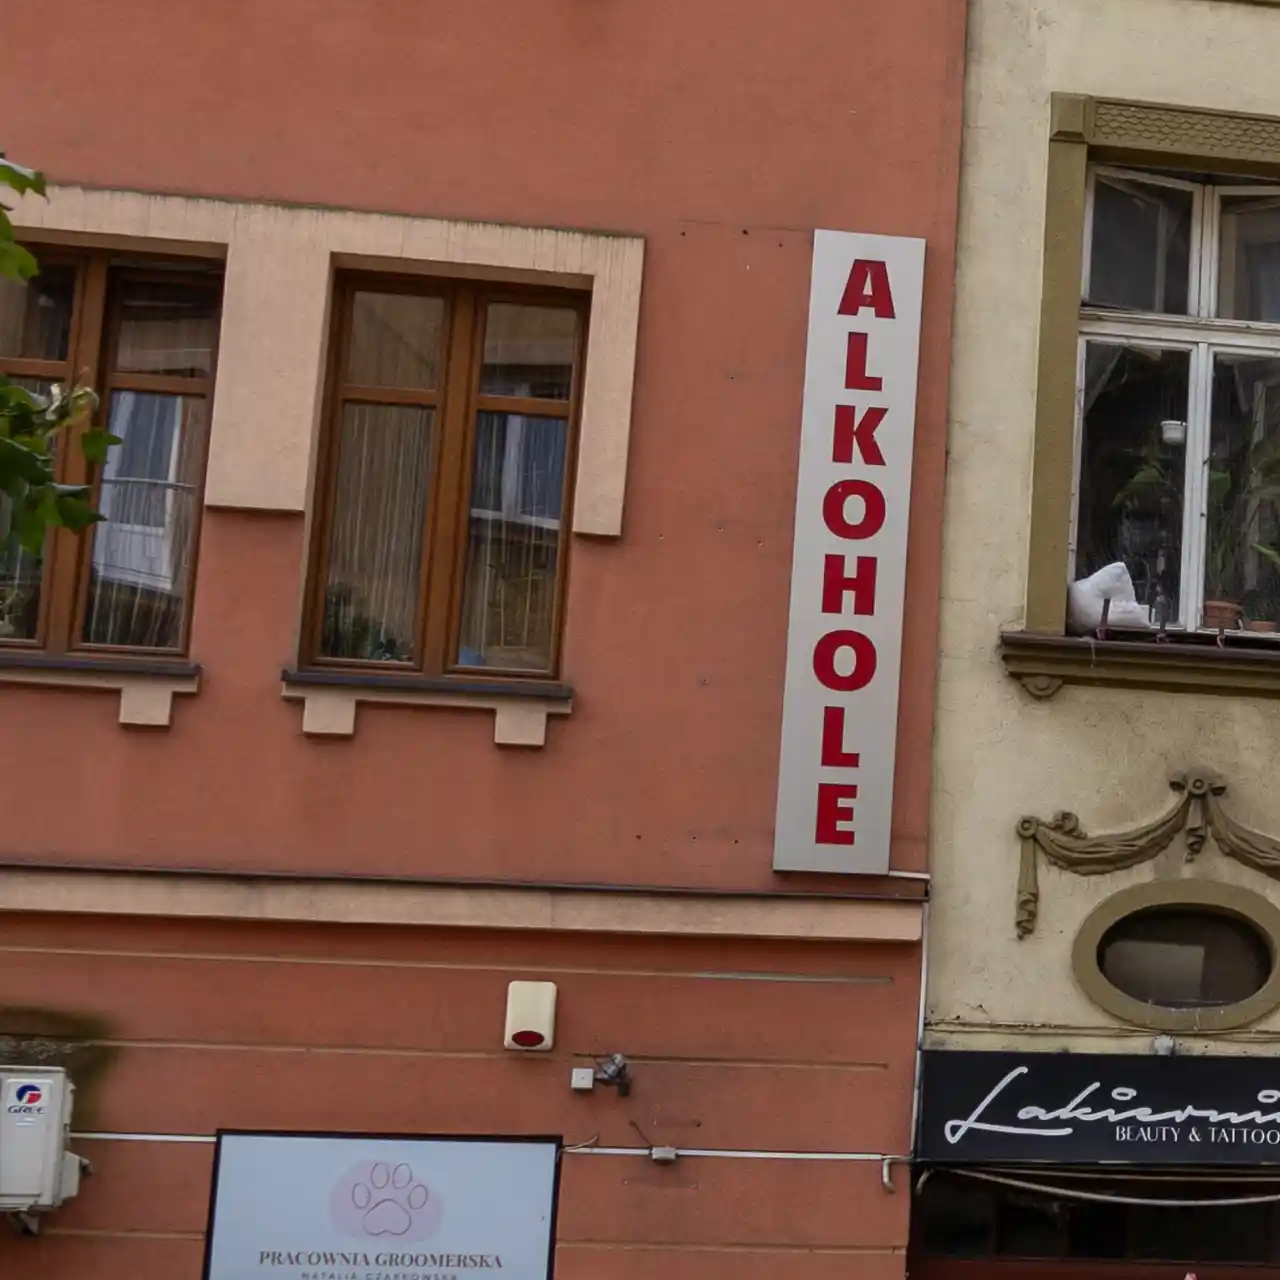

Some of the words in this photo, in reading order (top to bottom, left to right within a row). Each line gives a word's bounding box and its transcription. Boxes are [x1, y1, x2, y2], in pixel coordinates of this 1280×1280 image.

[812, 259, 896, 845] ALKOHOLE
[1116, 1126, 1181, 1142] BEAUTY
[1189, 1128, 1202, 1142] &
[1208, 1127, 1280, 1144] TATTOO
[258, 1251, 370, 1267] PRACOWNIA
[374, 1252, 503, 1269] GROOMERSKA
[301, 1272, 358, 1280] NATALIA
